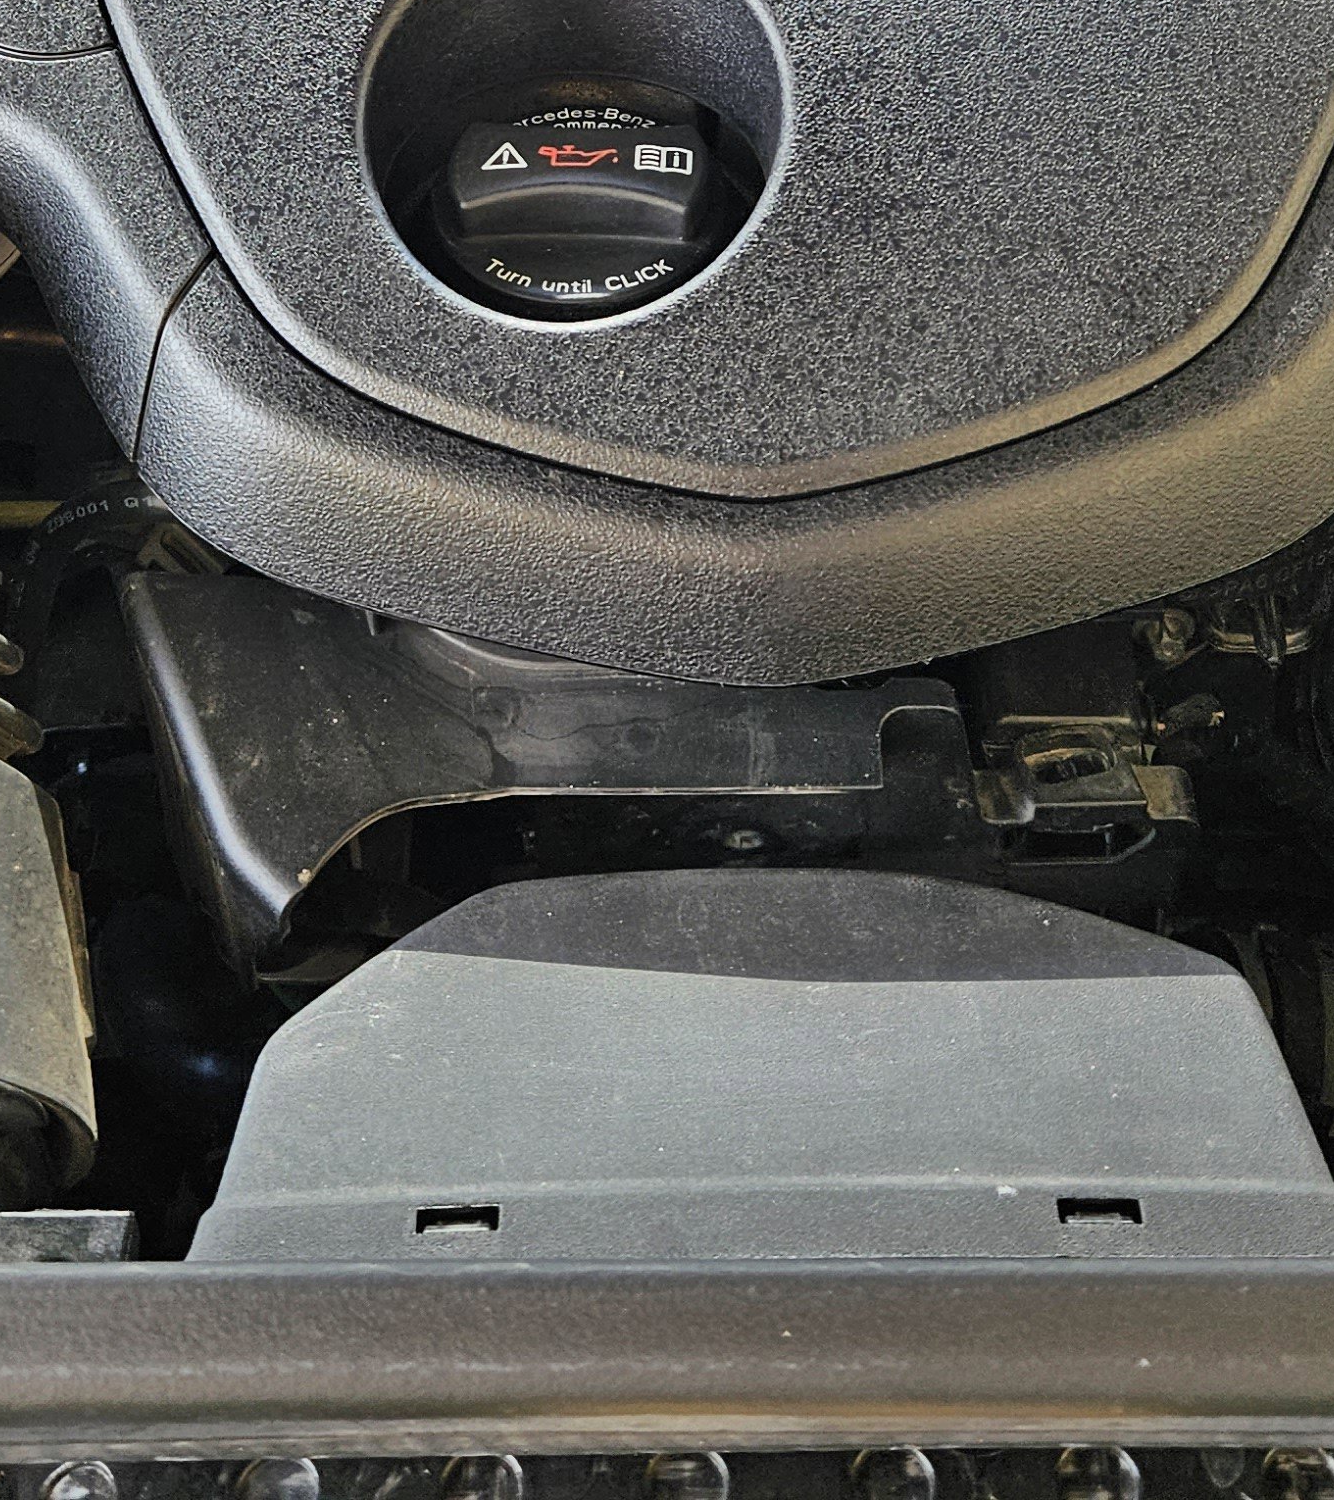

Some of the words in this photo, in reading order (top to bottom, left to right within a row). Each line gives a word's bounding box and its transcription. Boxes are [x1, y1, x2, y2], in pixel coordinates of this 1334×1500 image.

[512, 107, 656, 129] rcedes-Benz
[485, 258, 533, 288] Turn
[542, 277, 592, 294] until
[604, 258, 674, 292] CLICK
